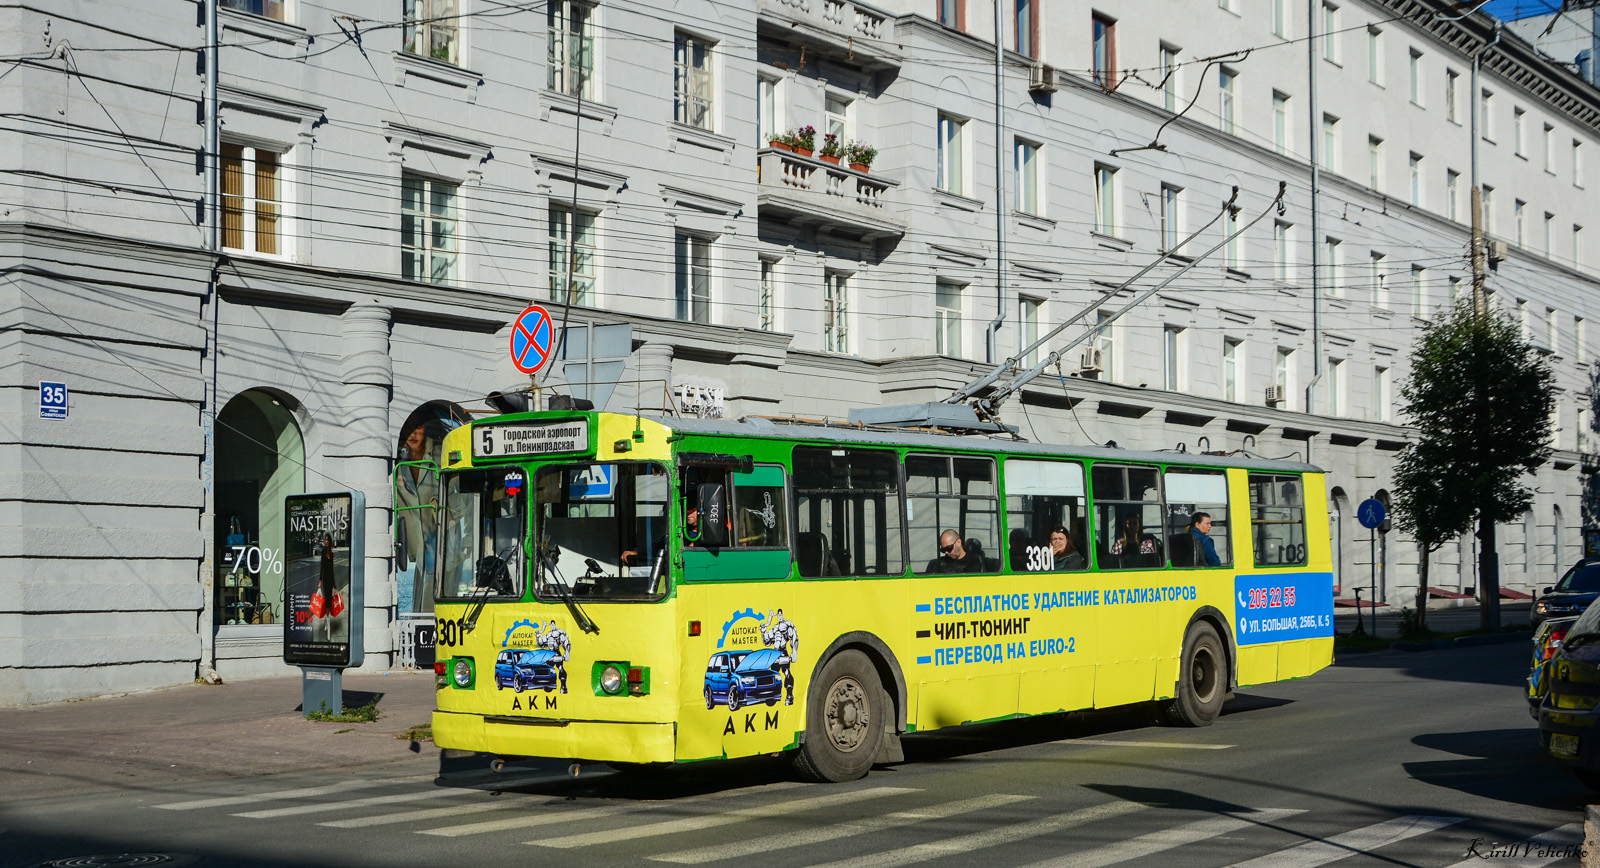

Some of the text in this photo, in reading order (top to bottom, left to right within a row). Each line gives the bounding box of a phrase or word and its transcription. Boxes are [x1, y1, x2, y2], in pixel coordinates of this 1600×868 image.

[43, 386, 64, 404] 35
[482, 430, 493, 455] 5
[503, 427, 581, 441] Городской аэропорт
[503, 440, 574, 454] ул. Ленинградская
[709, 502, 719, 524] 3301
[290, 514, 348, 532] NASTEN'S
[1025, 545, 1055, 571] 3301
[934, 585, 1197, 615] БЕСПЛАТНОЕ УДАЛЕНИЕ КАТАЛИЗАТОРОВ
[1248, 586, 1296, 609] 205 22 55
[295, 611, 314, 623] 10%
[1249, 614, 1330, 633] УЛ. БОЛЬШАЯ, 256Б, К. 5
[731, 626, 758, 636] AUTOKAT
[934, 617, 1031, 640] ЧИП-ТЮНИНГ
[731, 636, 758, 645] MASTER
[934, 636, 1076, 666] ПЕРЕВОД НА EURO-2
